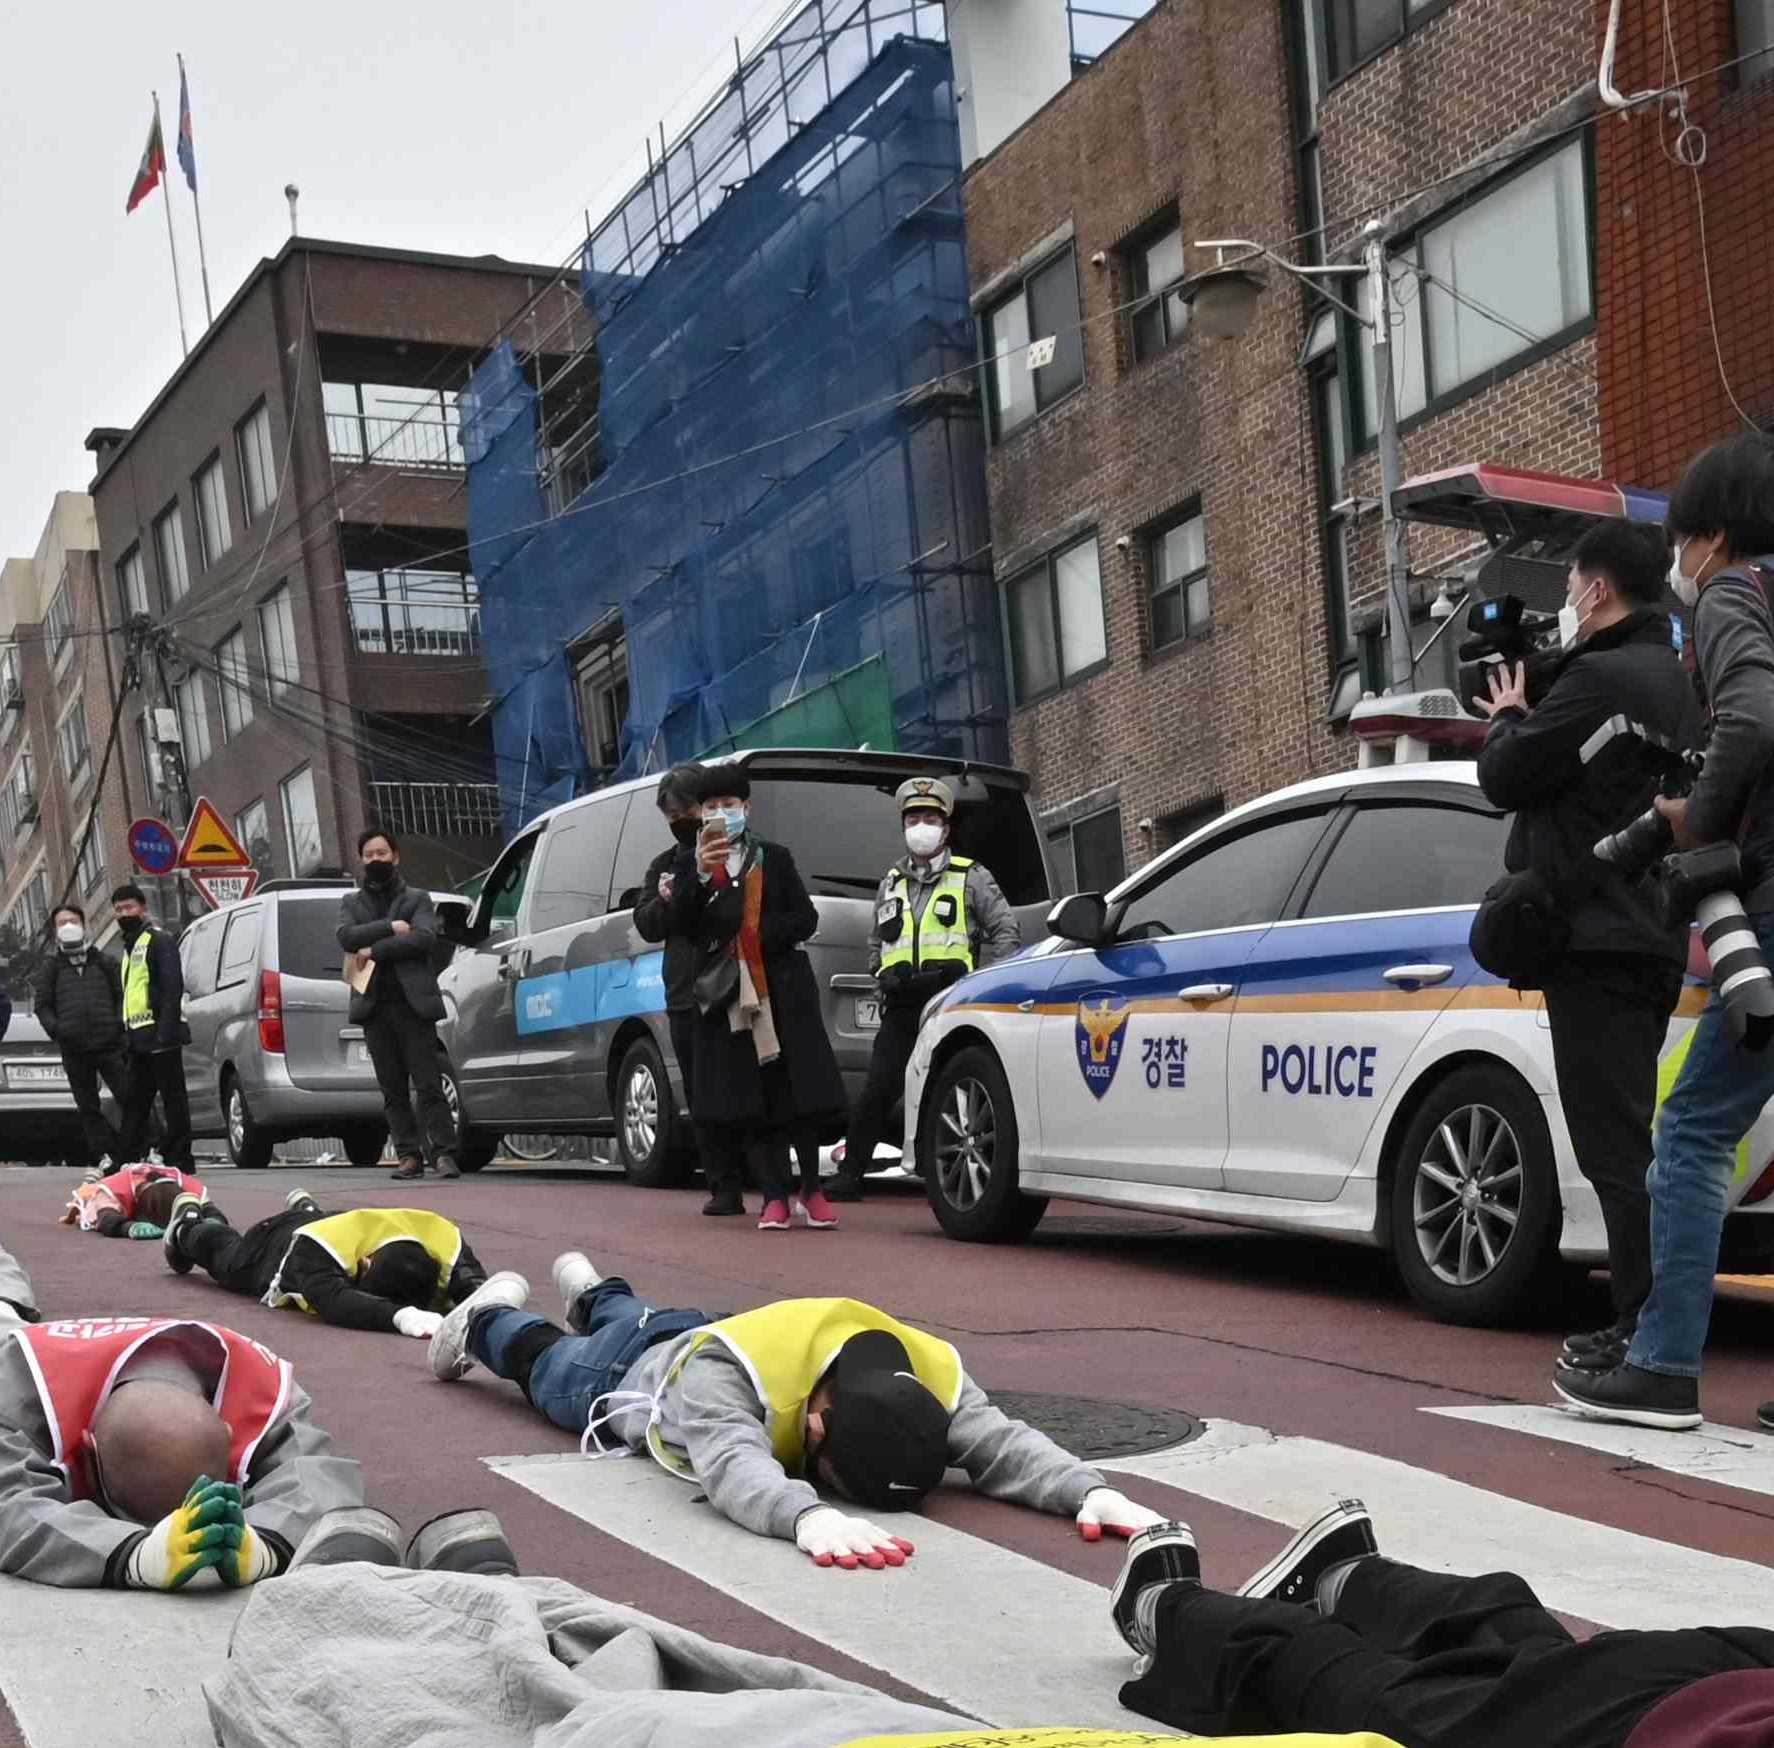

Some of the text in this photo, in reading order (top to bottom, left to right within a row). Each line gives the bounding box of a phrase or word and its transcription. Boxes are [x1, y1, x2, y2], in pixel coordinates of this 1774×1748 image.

[209, 879, 242, 892] 천천히
[1087, 1065, 1111, 1078] POLICE
[1141, 1035, 1188, 1089] 경찰
[1261, 1043, 1378, 1097] POLICE
